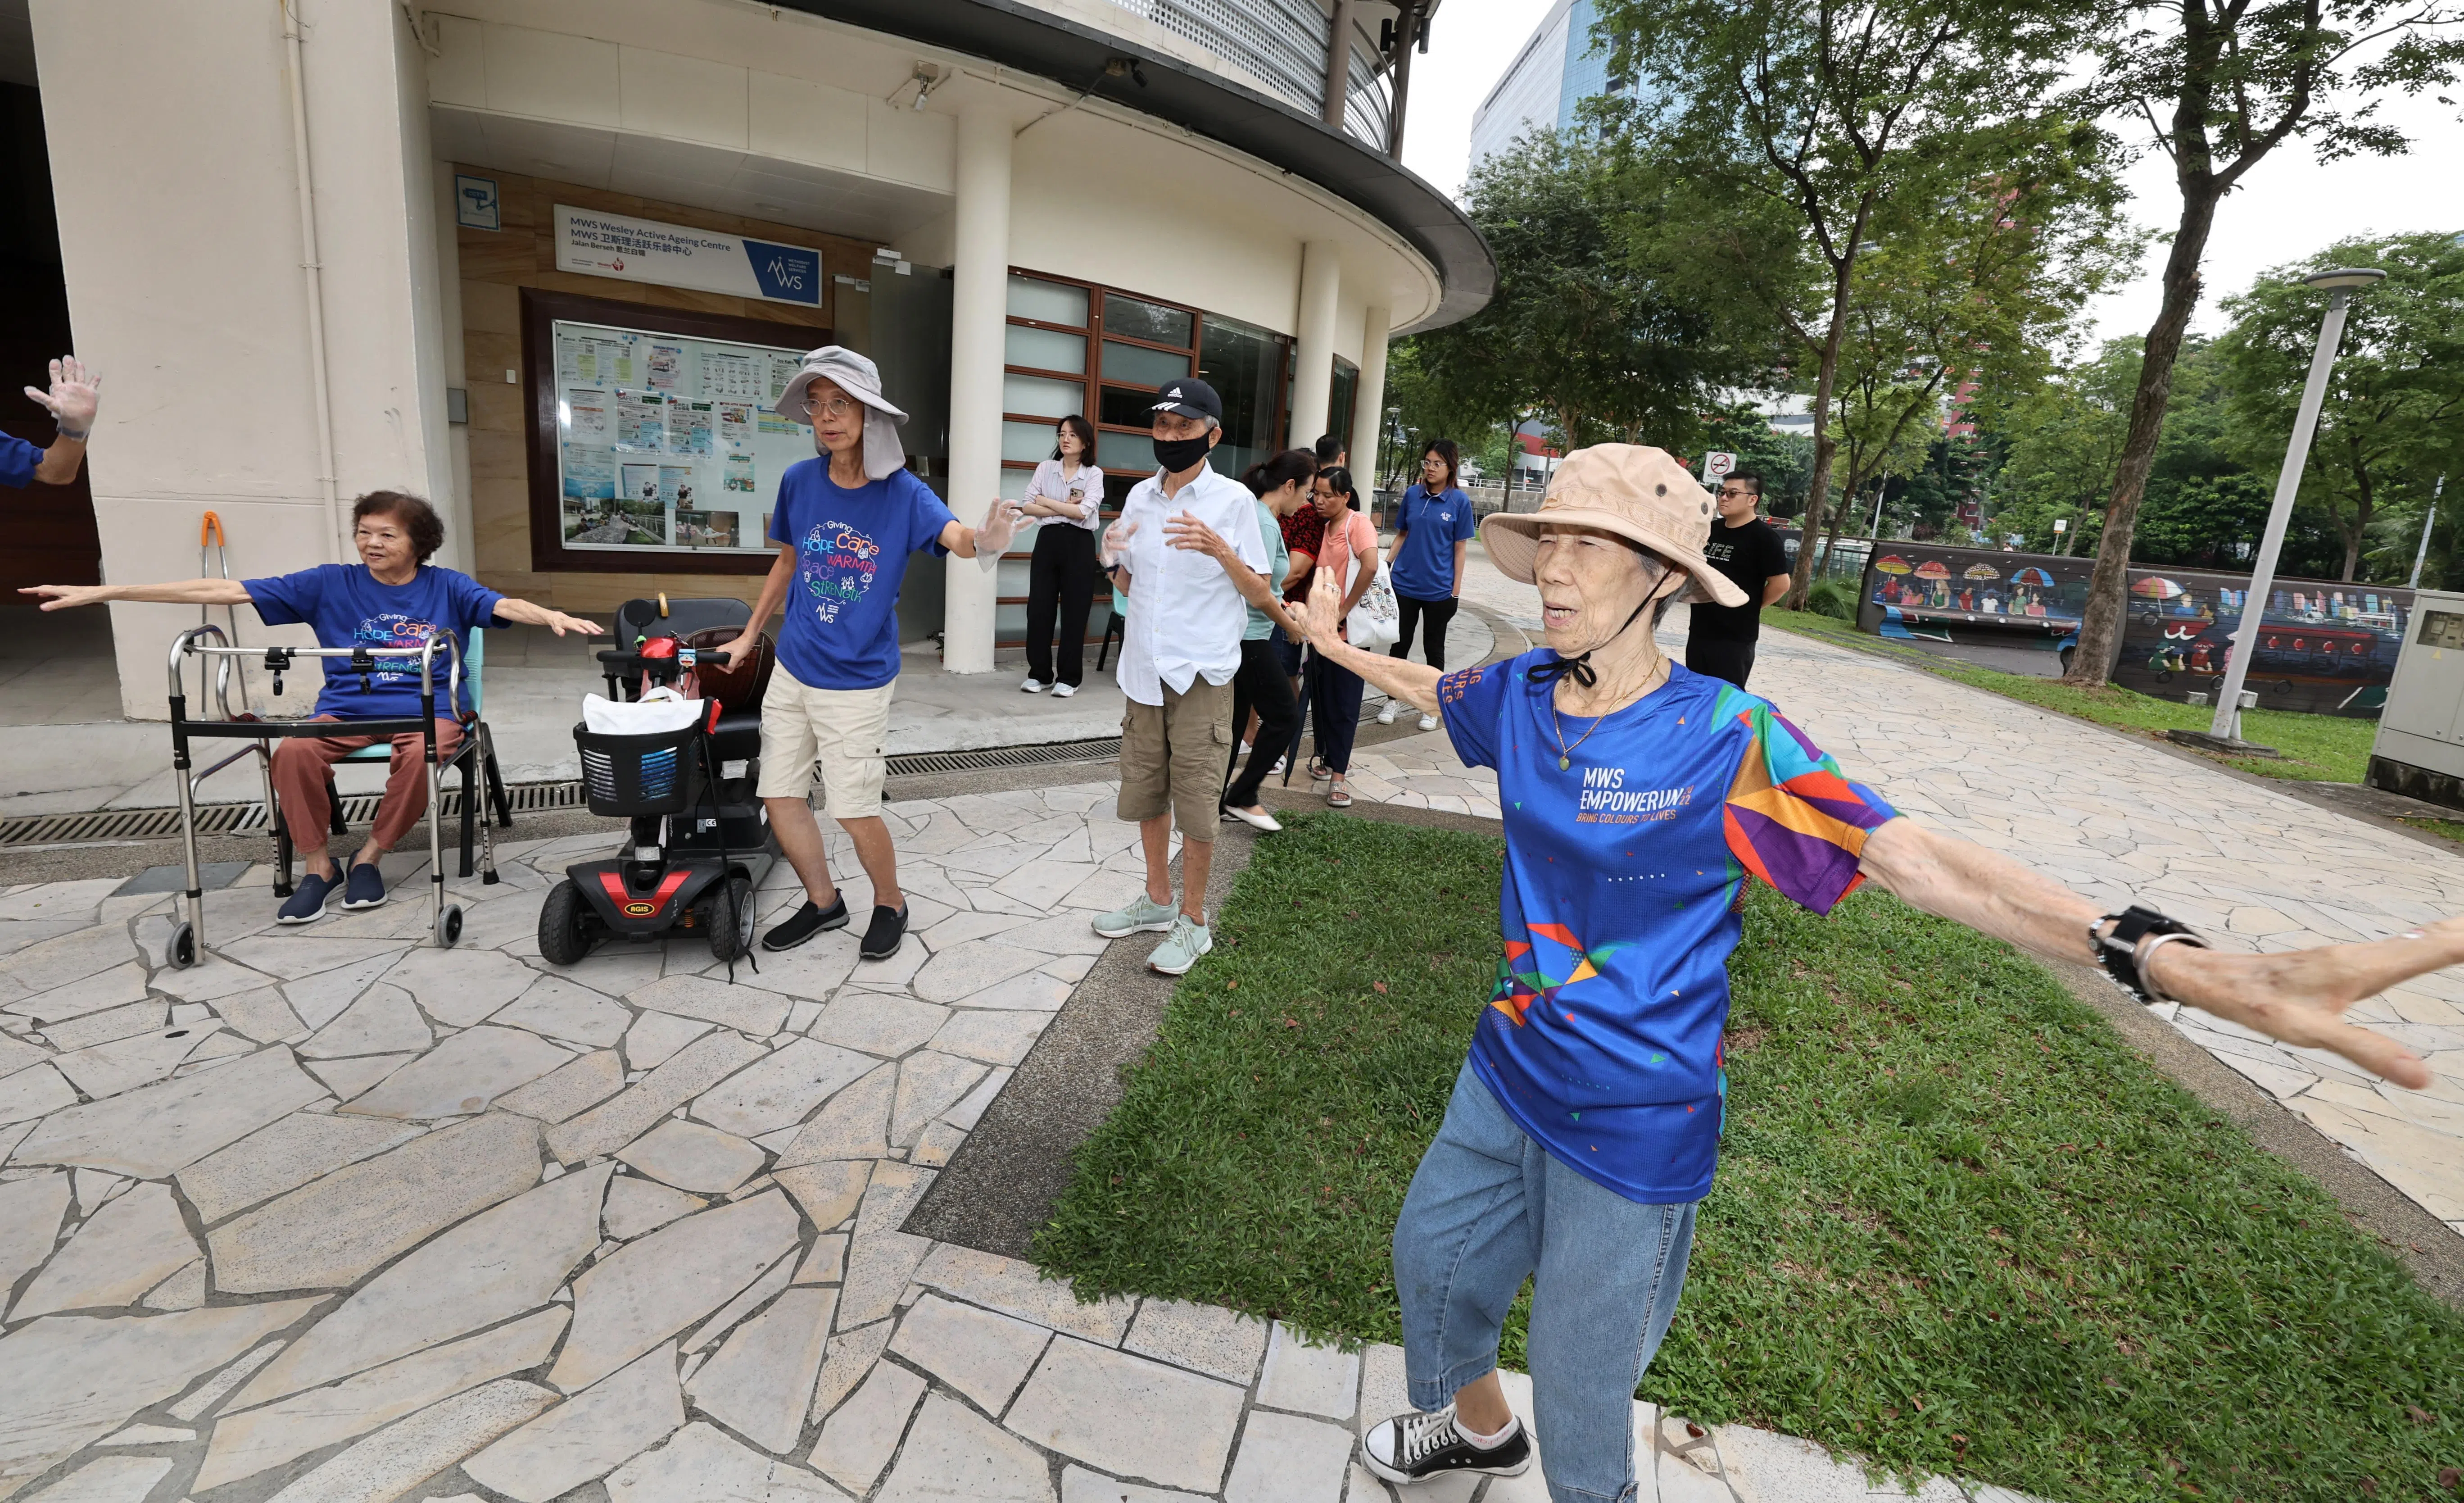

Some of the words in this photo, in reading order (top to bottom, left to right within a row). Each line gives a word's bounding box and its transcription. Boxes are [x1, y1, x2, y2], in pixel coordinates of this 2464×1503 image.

[571, 217, 598, 229] MWS
[600, 222, 634, 236] Wesley
[636, 229, 666, 240] Active
[668, 234, 699, 247] Ageing
[701, 240, 731, 251] Centre
[571, 229, 598, 240] MWS
[571, 239, 589, 247] Jalan
[591, 242, 615, 251] Berseh
[767, 256, 802, 290] MWS
[827, 520, 852, 535] Giving
[1703, 542, 1734, 558] IFE
[826, 554, 878, 575] WARMTH
[379, 613, 408, 622] Giving
[382, 639, 426, 648] WARM
[1583, 767, 1625, 789] MWS
[1579, 788, 1685, 812] EMPOWERUN
[1679, 795, 1691, 805] 22
[1576, 813, 1598, 823] BRING
[1599, 813, 1640, 824] COLOURS
[1642, 814, 1650, 822] TO
[1650, 809, 1676, 822] LIVES
